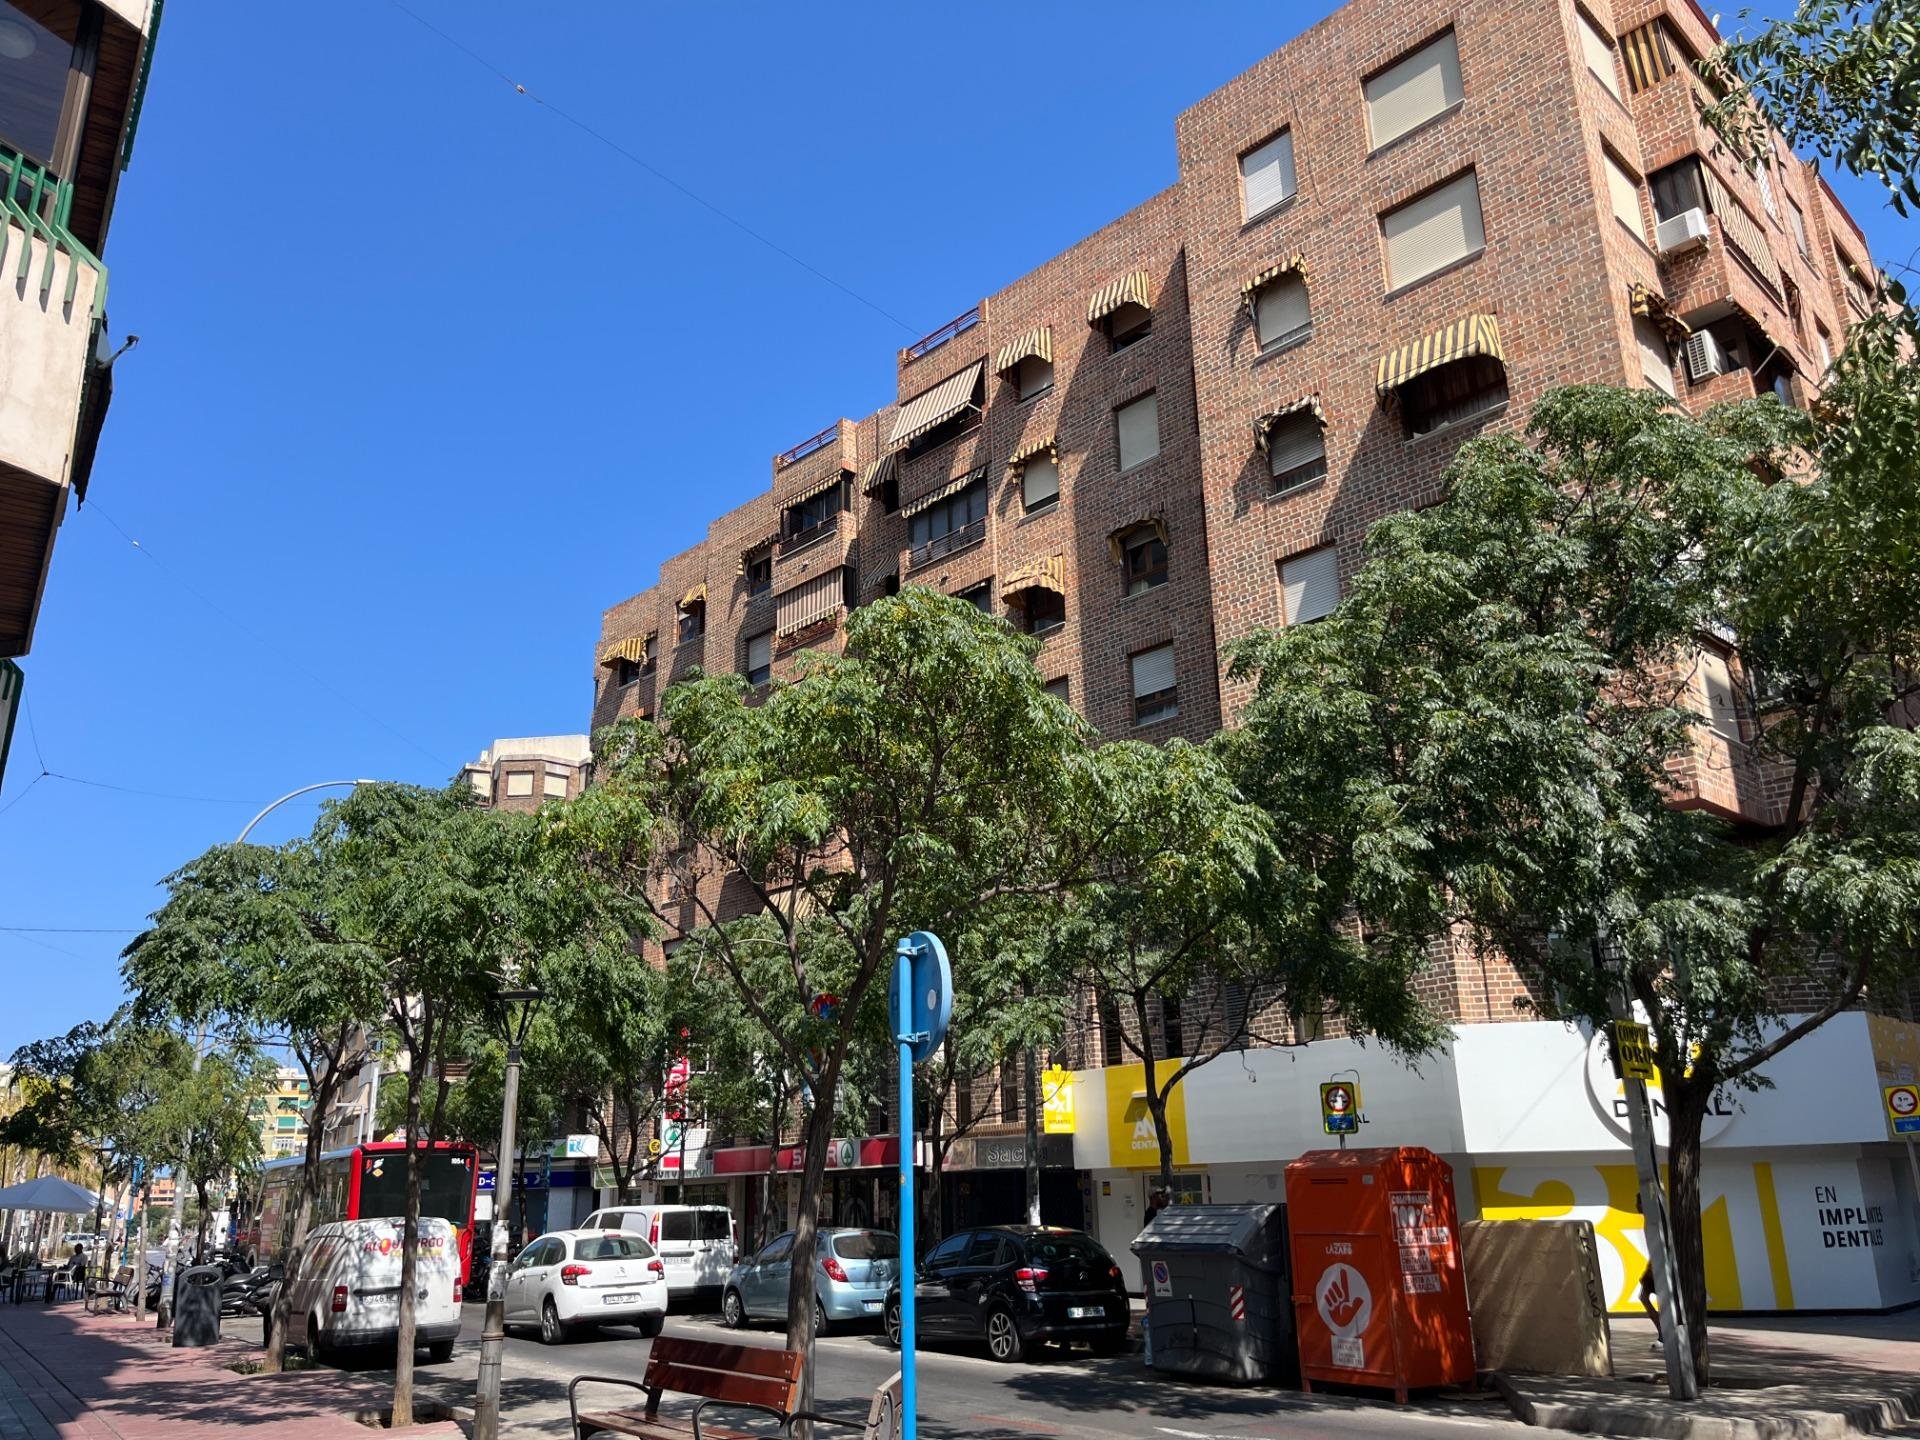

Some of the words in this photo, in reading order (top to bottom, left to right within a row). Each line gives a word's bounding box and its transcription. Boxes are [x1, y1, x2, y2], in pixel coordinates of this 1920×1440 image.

[1621, 1045, 1652, 1065] ORO
[1131, 1139, 1161, 1150] DENTA
[1815, 1186, 1837, 1203] EN
